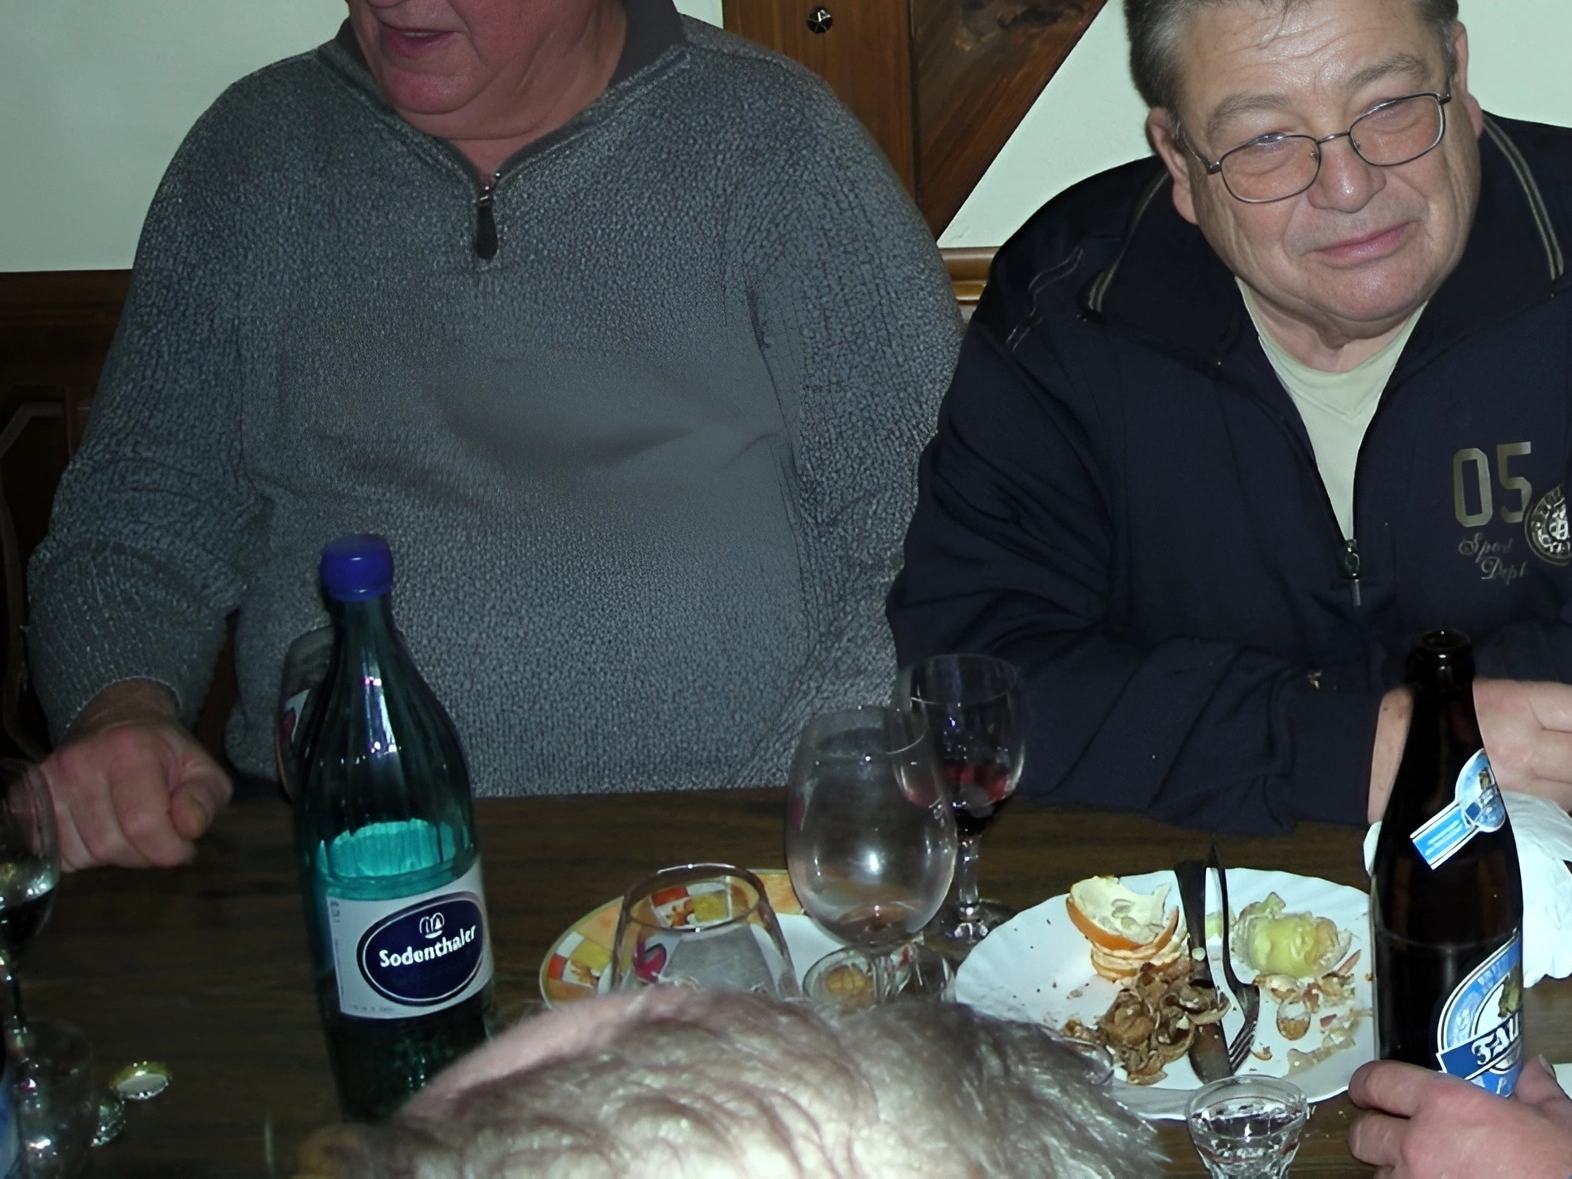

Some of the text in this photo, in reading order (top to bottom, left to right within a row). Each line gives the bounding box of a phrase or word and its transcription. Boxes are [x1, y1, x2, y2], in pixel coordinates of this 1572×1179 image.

[1453, 440, 1532, 528] 05
[1458, 531, 1515, 564] Sport
[378, 924, 477, 968] Sodenthaler
